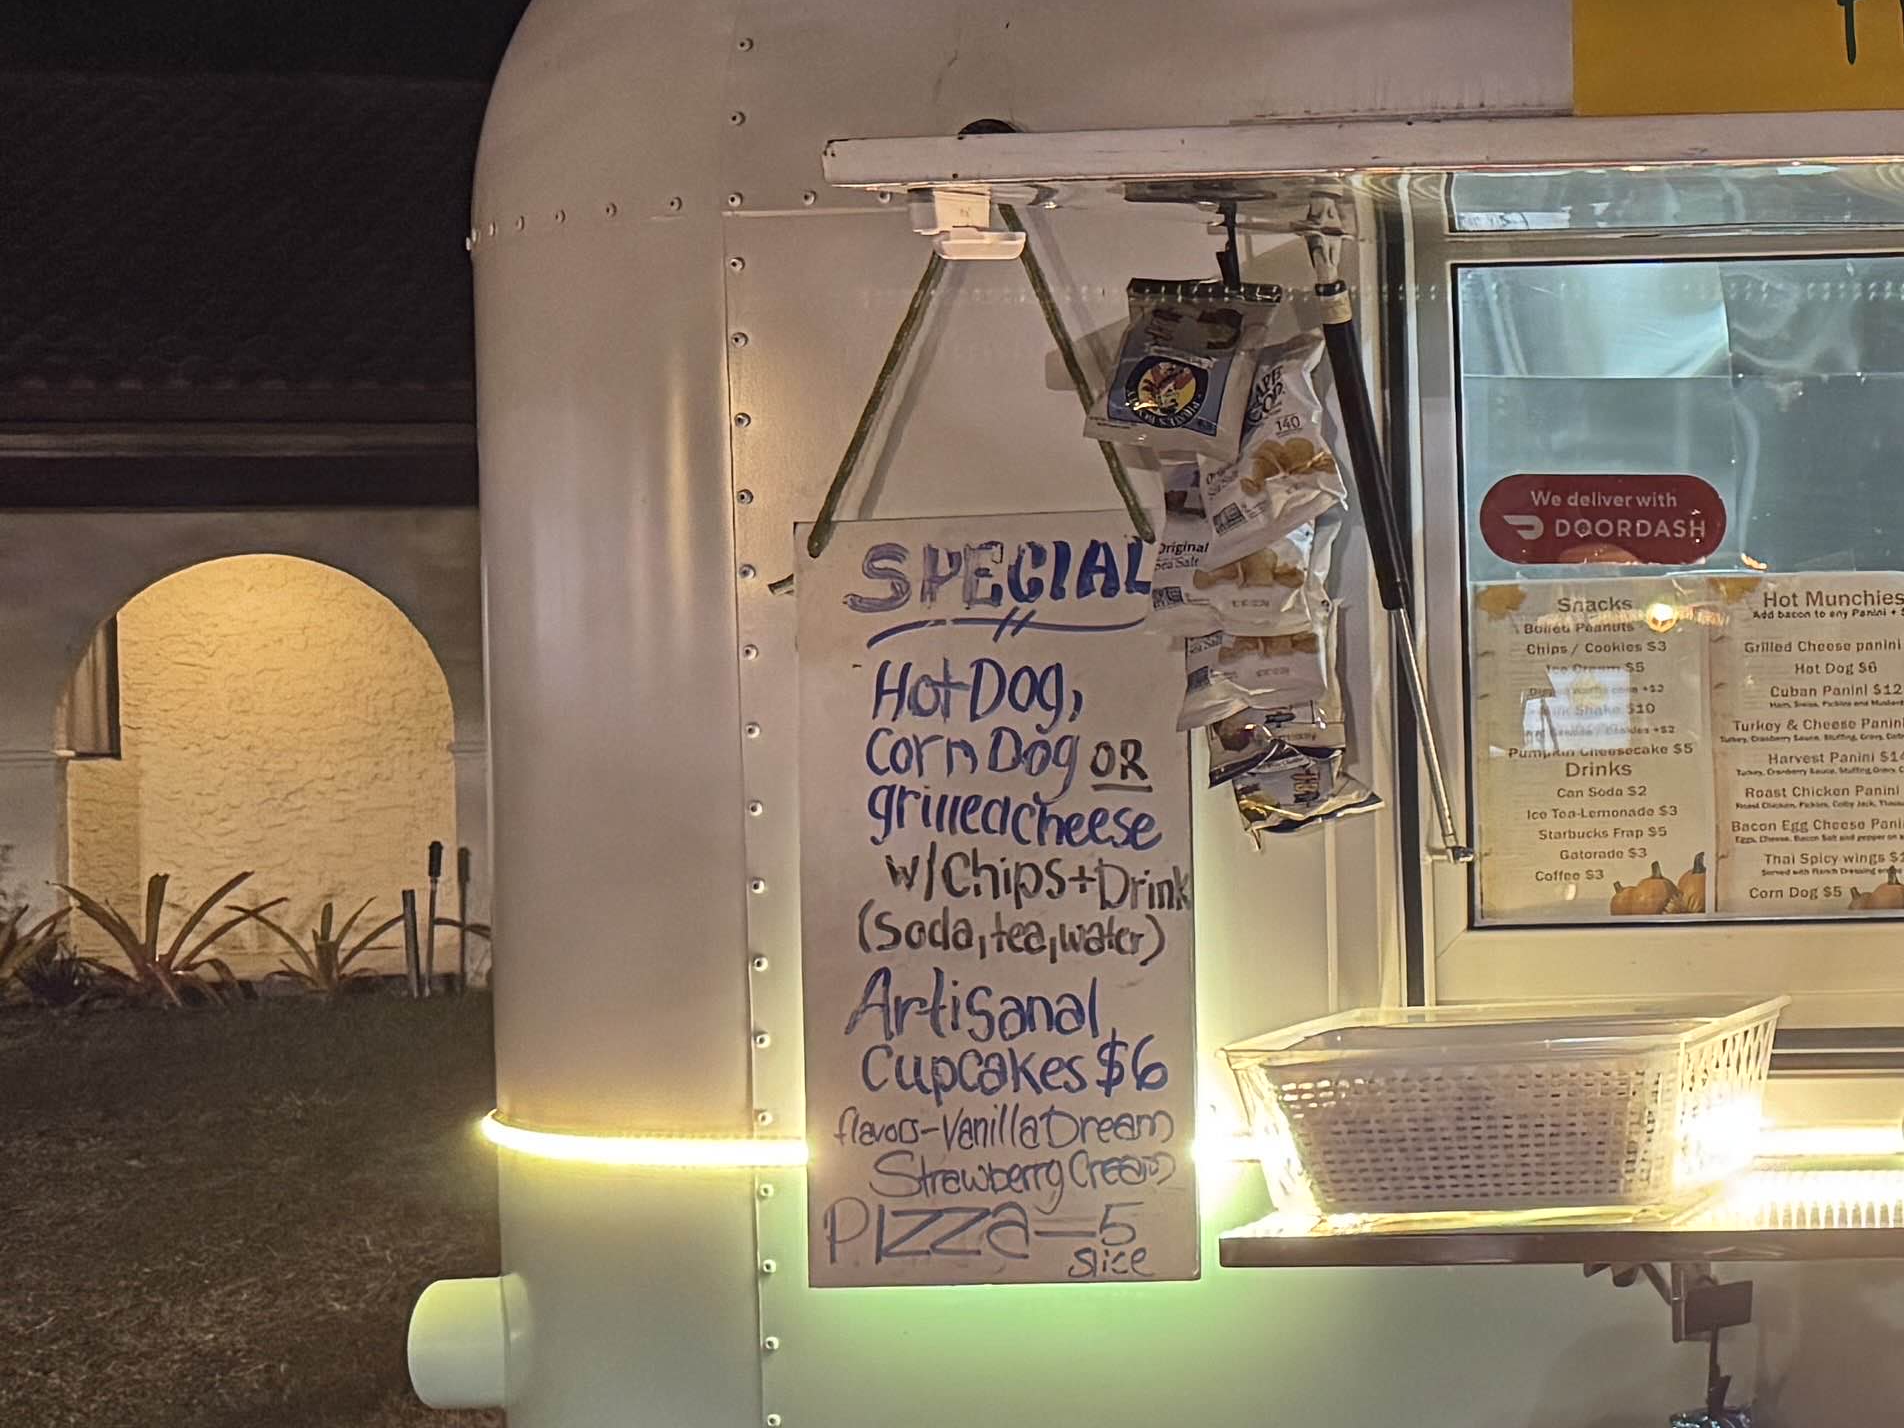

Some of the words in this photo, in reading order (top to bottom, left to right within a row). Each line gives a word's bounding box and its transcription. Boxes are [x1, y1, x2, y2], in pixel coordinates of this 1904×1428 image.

[1531, 491, 1561, 506] We
[1568, 492, 1632, 507] deliver
[1636, 492, 1677, 507] with
[1556, 519, 1705, 538] DOORDASH
[843, 536, 1152, 612] SPECIAL
[1558, 597, 1633, 613] Snacks
[1764, 592, 1798, 607] Hot
[1806, 590, 1904, 606] Munchies
[872, 657, 969, 722] Hot
[970, 658, 1083, 733] Dog,
[1771, 686, 1816, 697] Cuban
[866, 727, 978, 777] Corn
[989, 727, 1080, 805] Dog
[1090, 739, 1150, 781] OR
[1769, 754, 1824, 764] Harvest
[1566, 761, 1632, 777] Drinks
[1746, 788, 1786, 798] Roast
[1793, 786, 1849, 797] Chicken
[1539, 828, 1608, 840] Starbucks
[1732, 821, 1776, 832] Bacon
[1560, 850, 1623, 860] Gatorade
[1800, 853, 1838, 865] Spicy
[1843, 853, 1885, 865] wings
[1750, 887, 1783, 898] Corn
[844, 966, 1100, 1041] Artisanal
[862, 1044, 1088, 1106] Cupcakes
[1097, 1028, 1169, 1097] $6
[869, 1150, 1064, 1214] Strawberry
